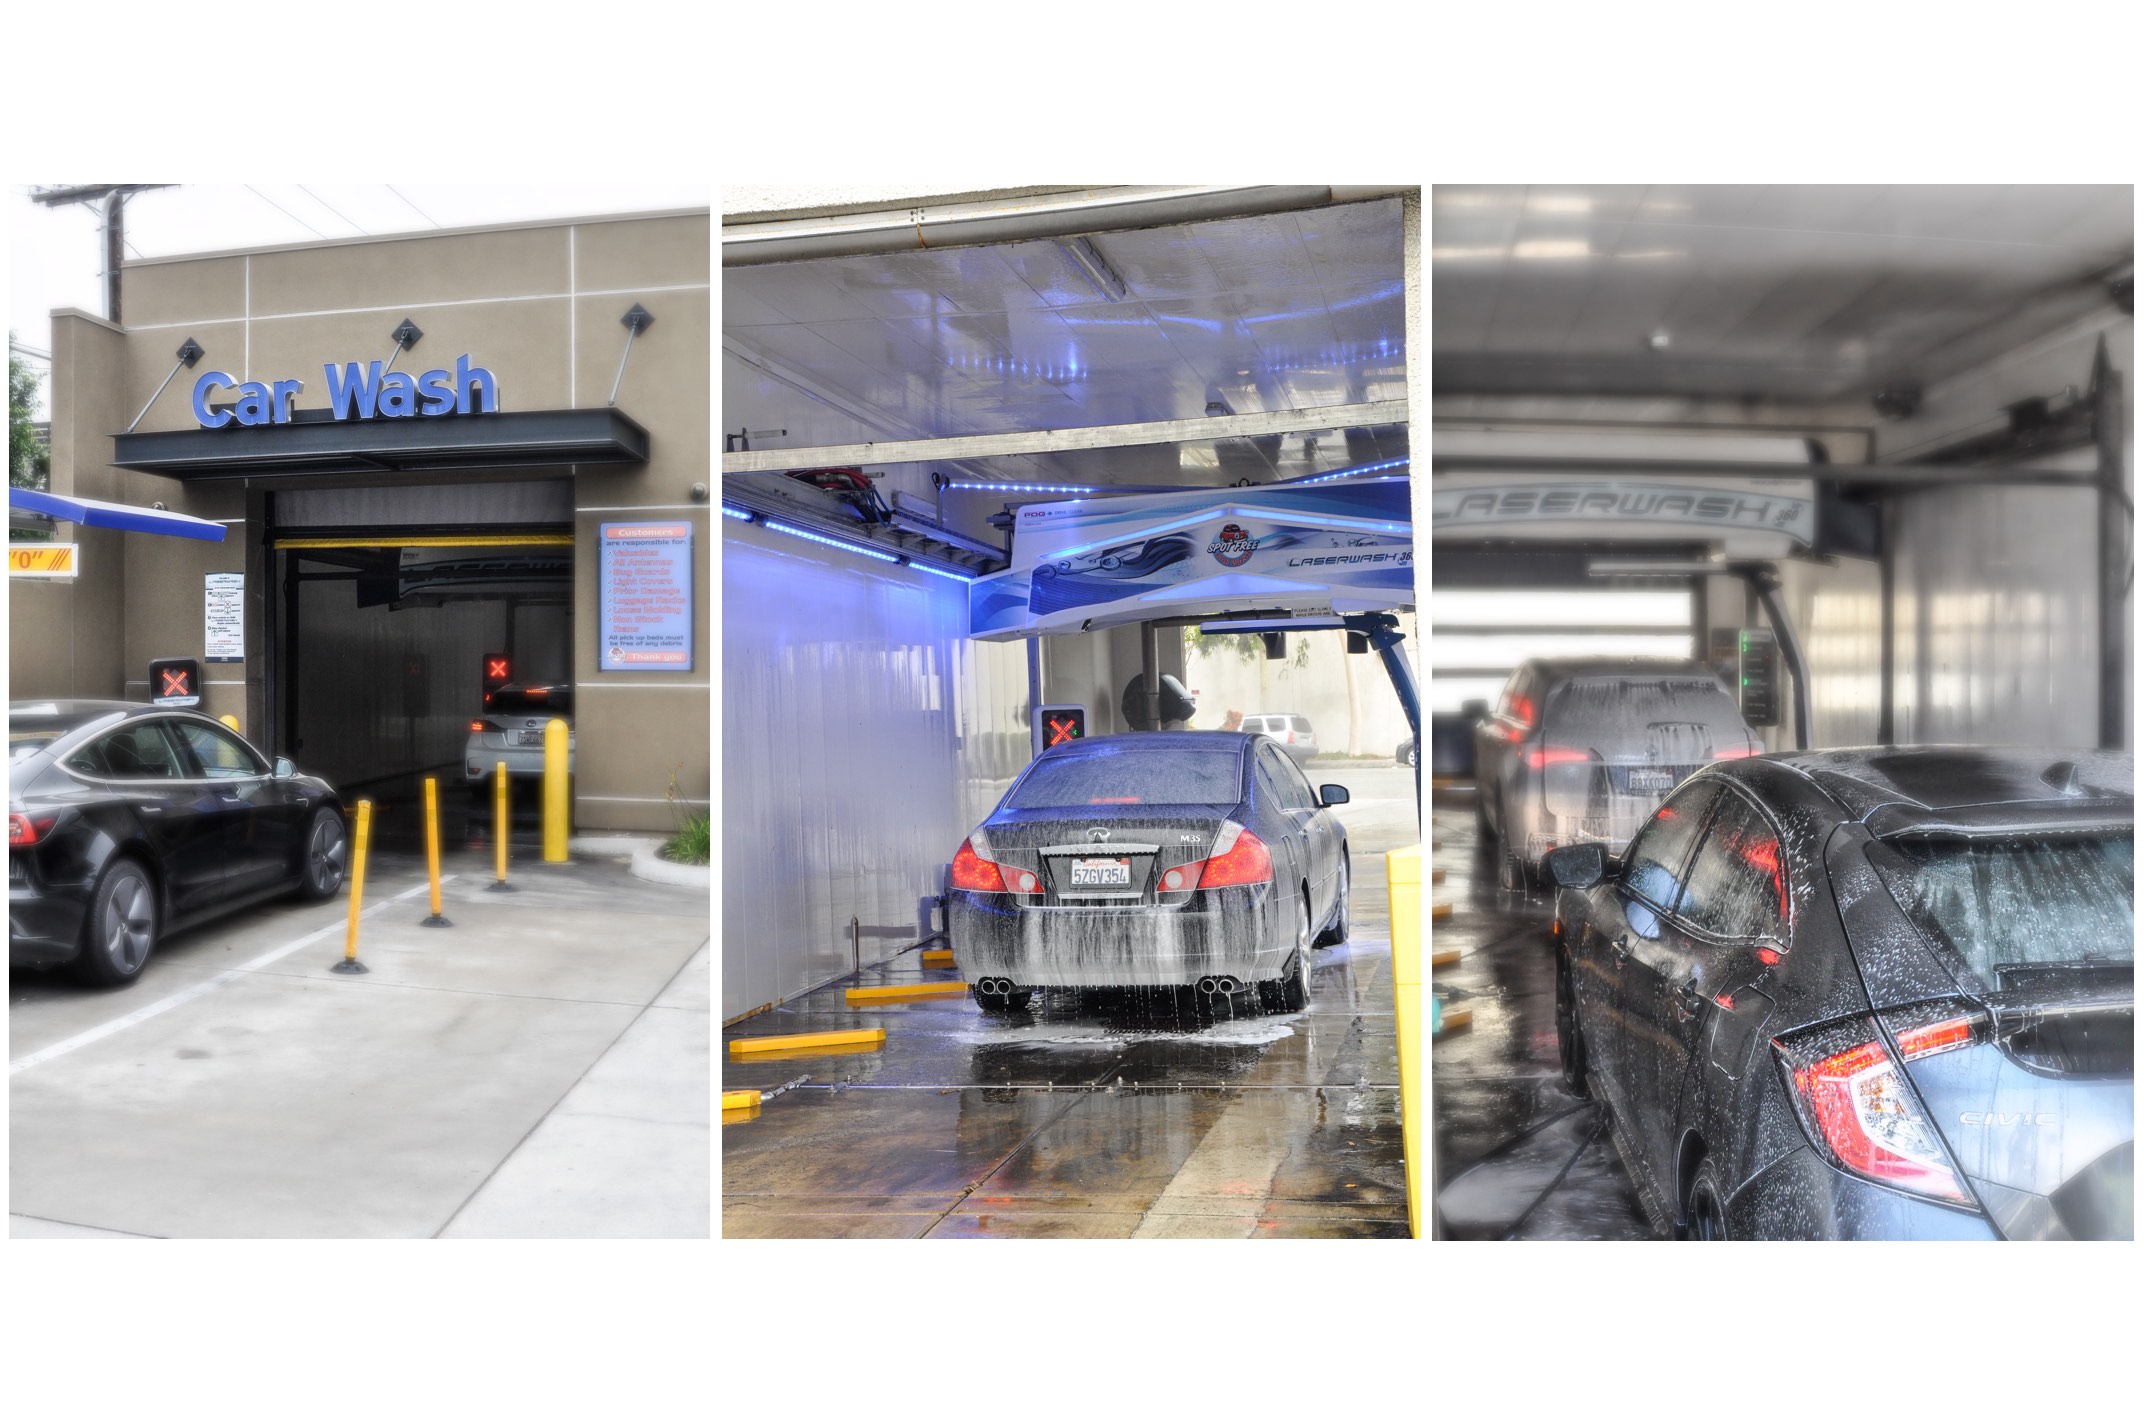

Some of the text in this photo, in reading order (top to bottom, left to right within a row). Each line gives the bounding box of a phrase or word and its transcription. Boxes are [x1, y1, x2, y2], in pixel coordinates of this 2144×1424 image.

[191, 353, 498, 428] Car Wash
[618, 529, 673, 537] Customers
[622, 539, 670, 547] responsible
[1207, 540, 1260, 553] SPOT FREE
[1288, 552, 1398, 567] LASERWASH
[613, 578, 638, 586] Light
[640, 587, 681, 596] Damage
[613, 606, 642, 614] Loose
[631, 653, 662, 661] Thank
[664, 654, 682, 662] you
[1083, 858, 1120, 869] California
[1074, 868, 1127, 883] 5ZGV354
[1959, 1111, 2057, 1126] CIVIC
